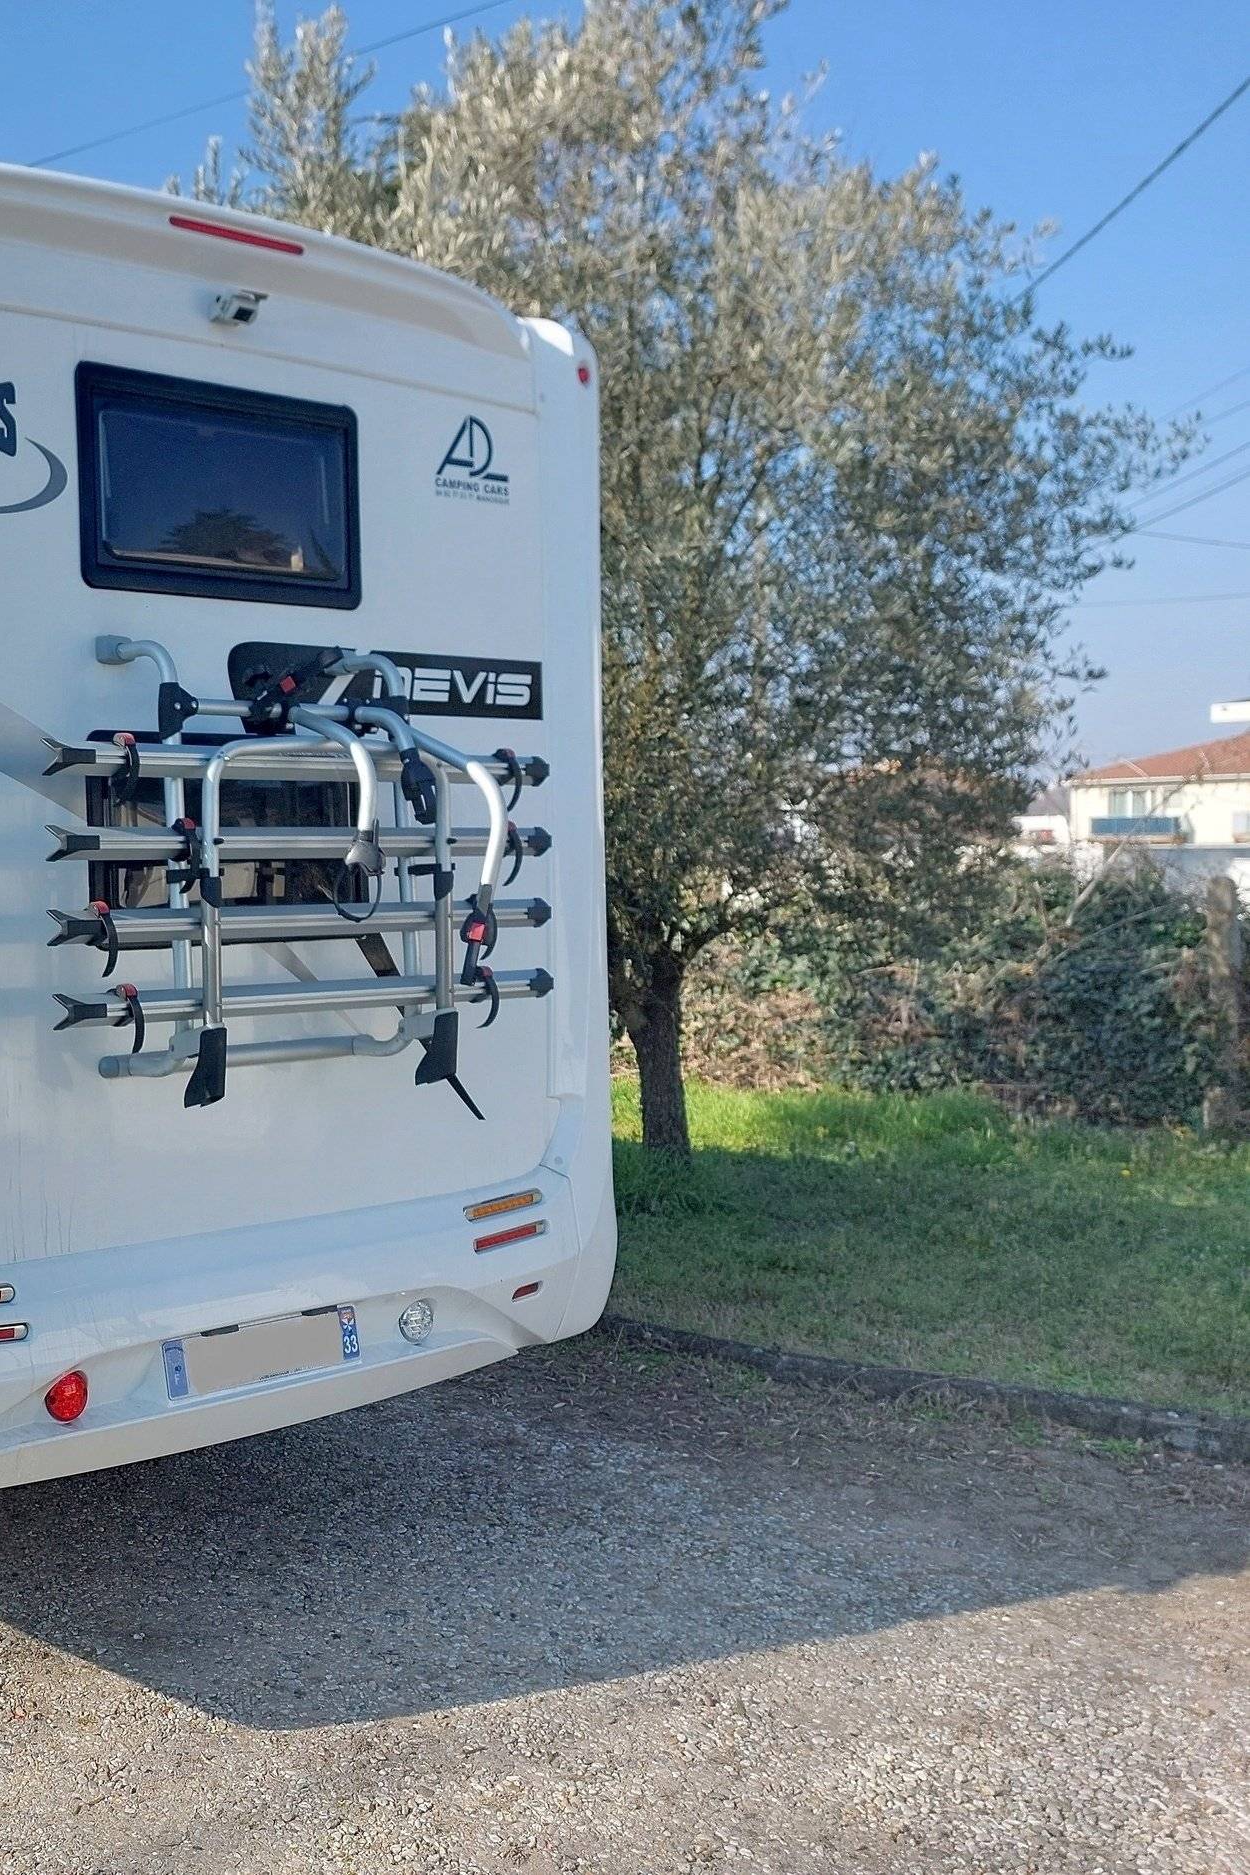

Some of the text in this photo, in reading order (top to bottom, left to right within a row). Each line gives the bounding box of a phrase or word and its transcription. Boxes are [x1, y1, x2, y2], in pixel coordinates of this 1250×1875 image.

[435, 477, 510, 496] CAMPING CARS
[343, 1334, 358, 1354] 33
